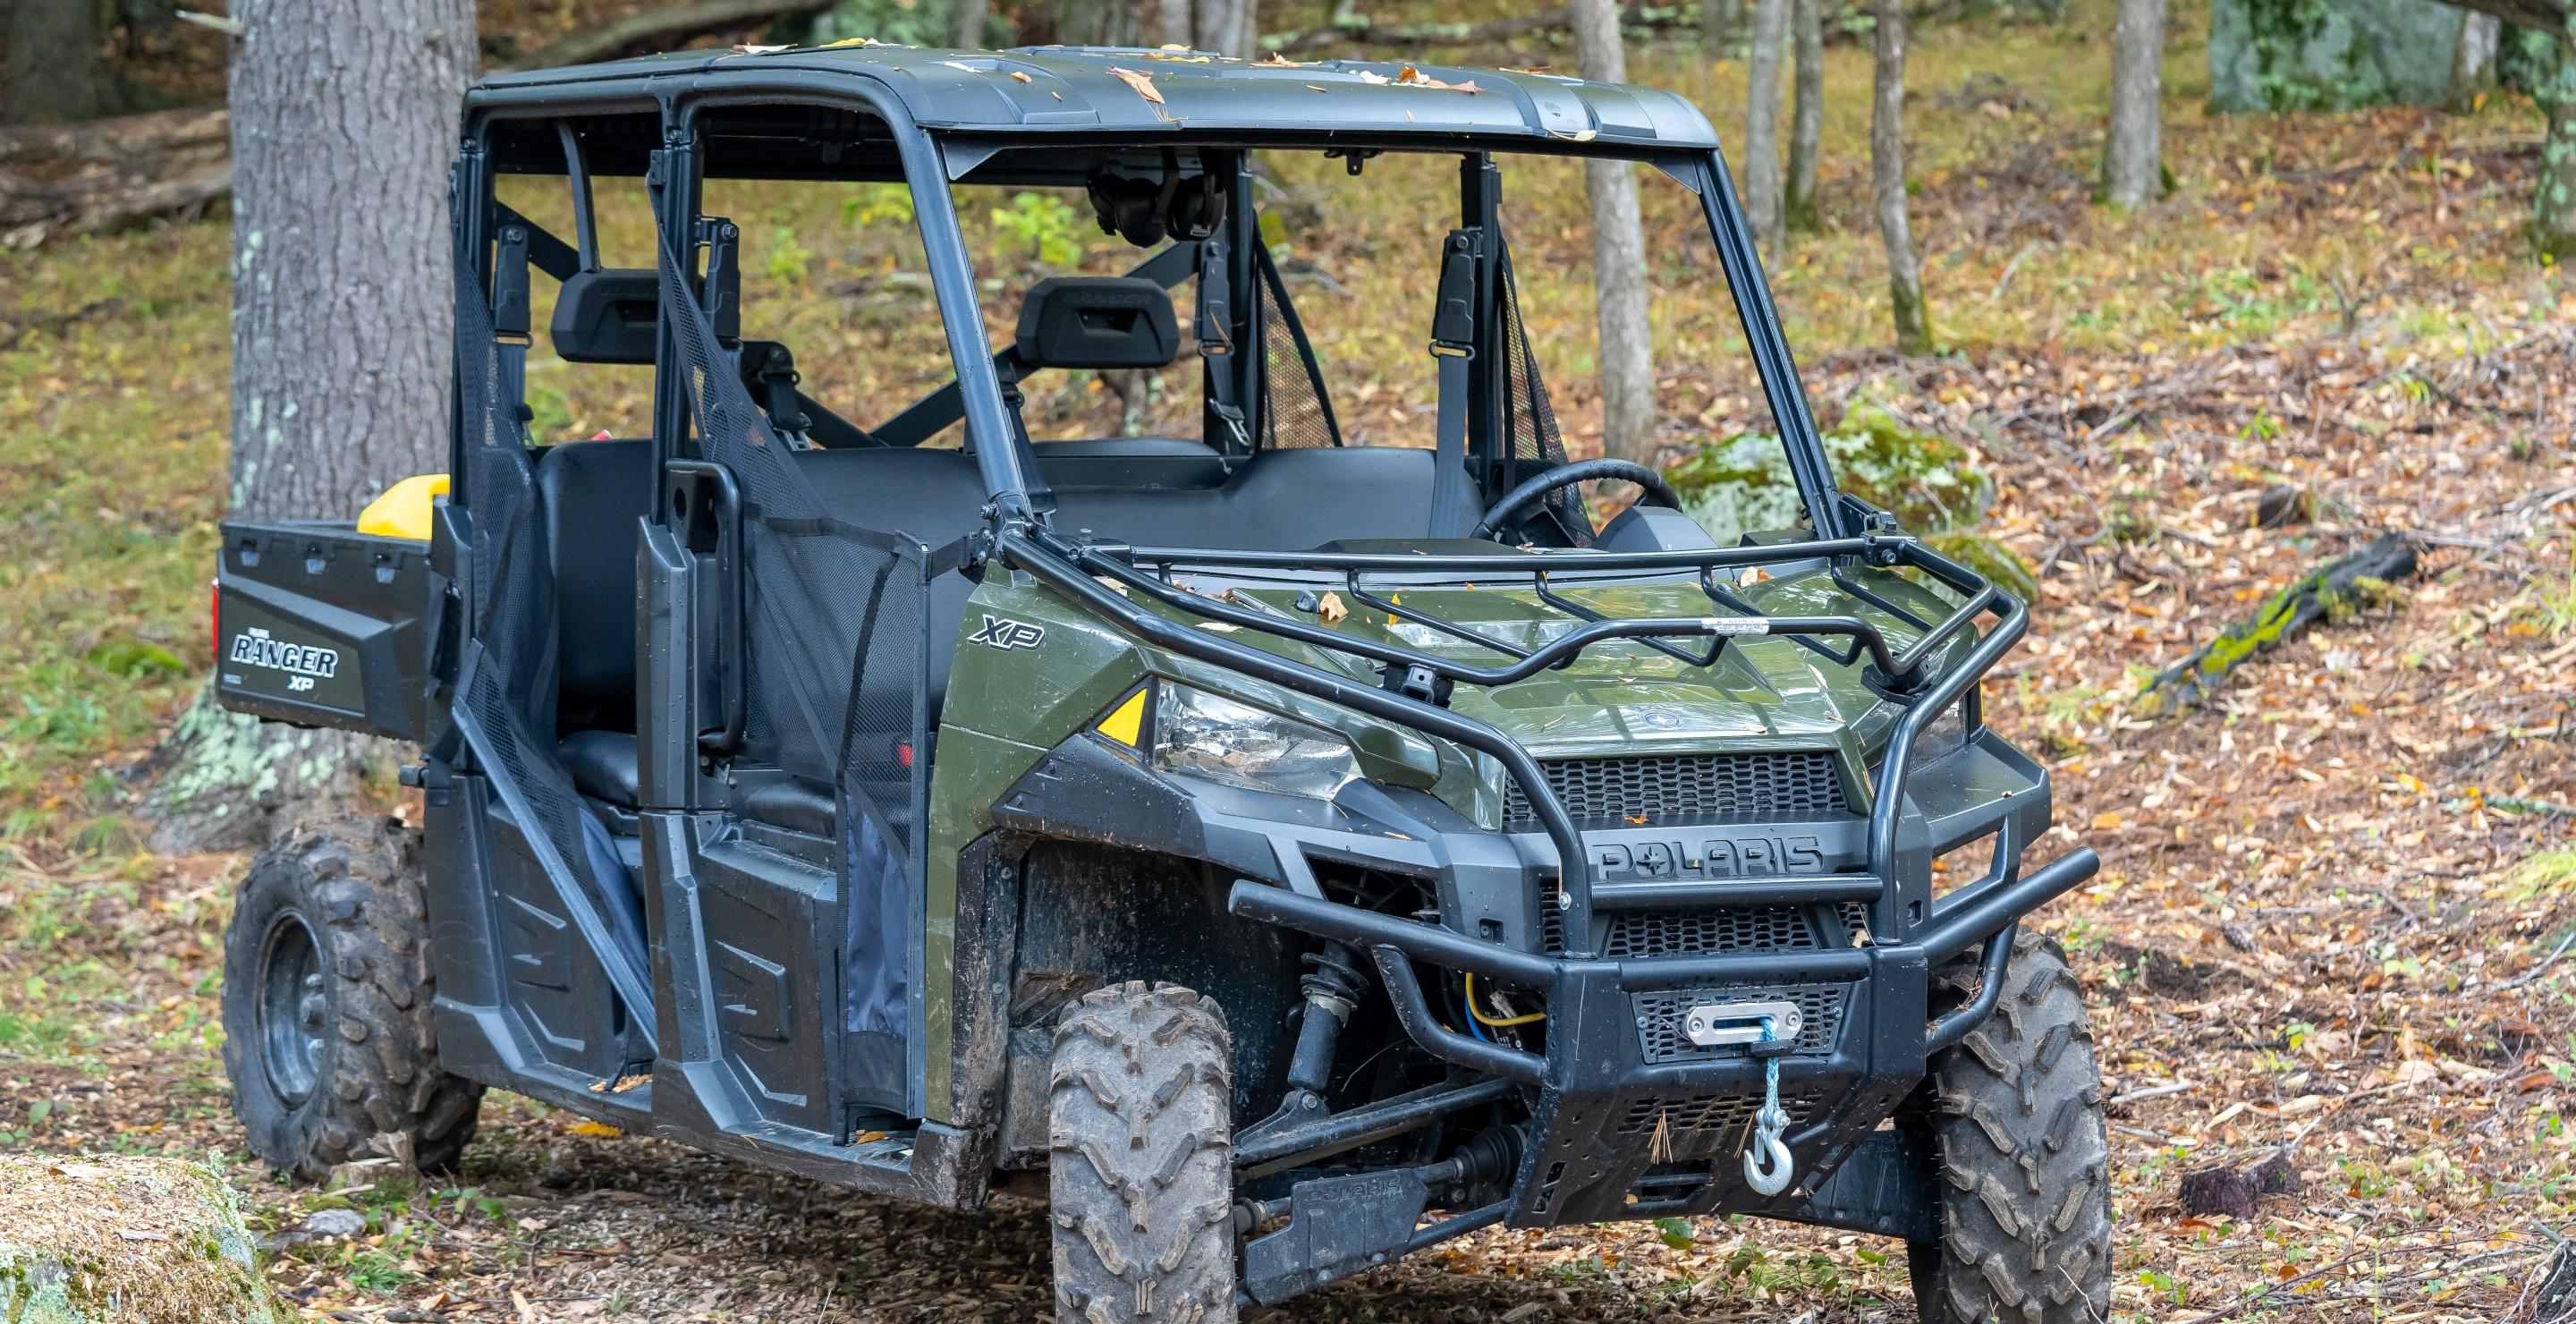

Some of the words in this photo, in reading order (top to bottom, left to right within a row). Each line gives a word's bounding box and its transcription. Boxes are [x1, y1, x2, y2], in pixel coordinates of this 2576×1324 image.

[967, 613, 1046, 653] XP
[230, 633, 338, 678] RANGER
[287, 675, 315, 692] XP
[1591, 836, 1825, 880] POLARIS
